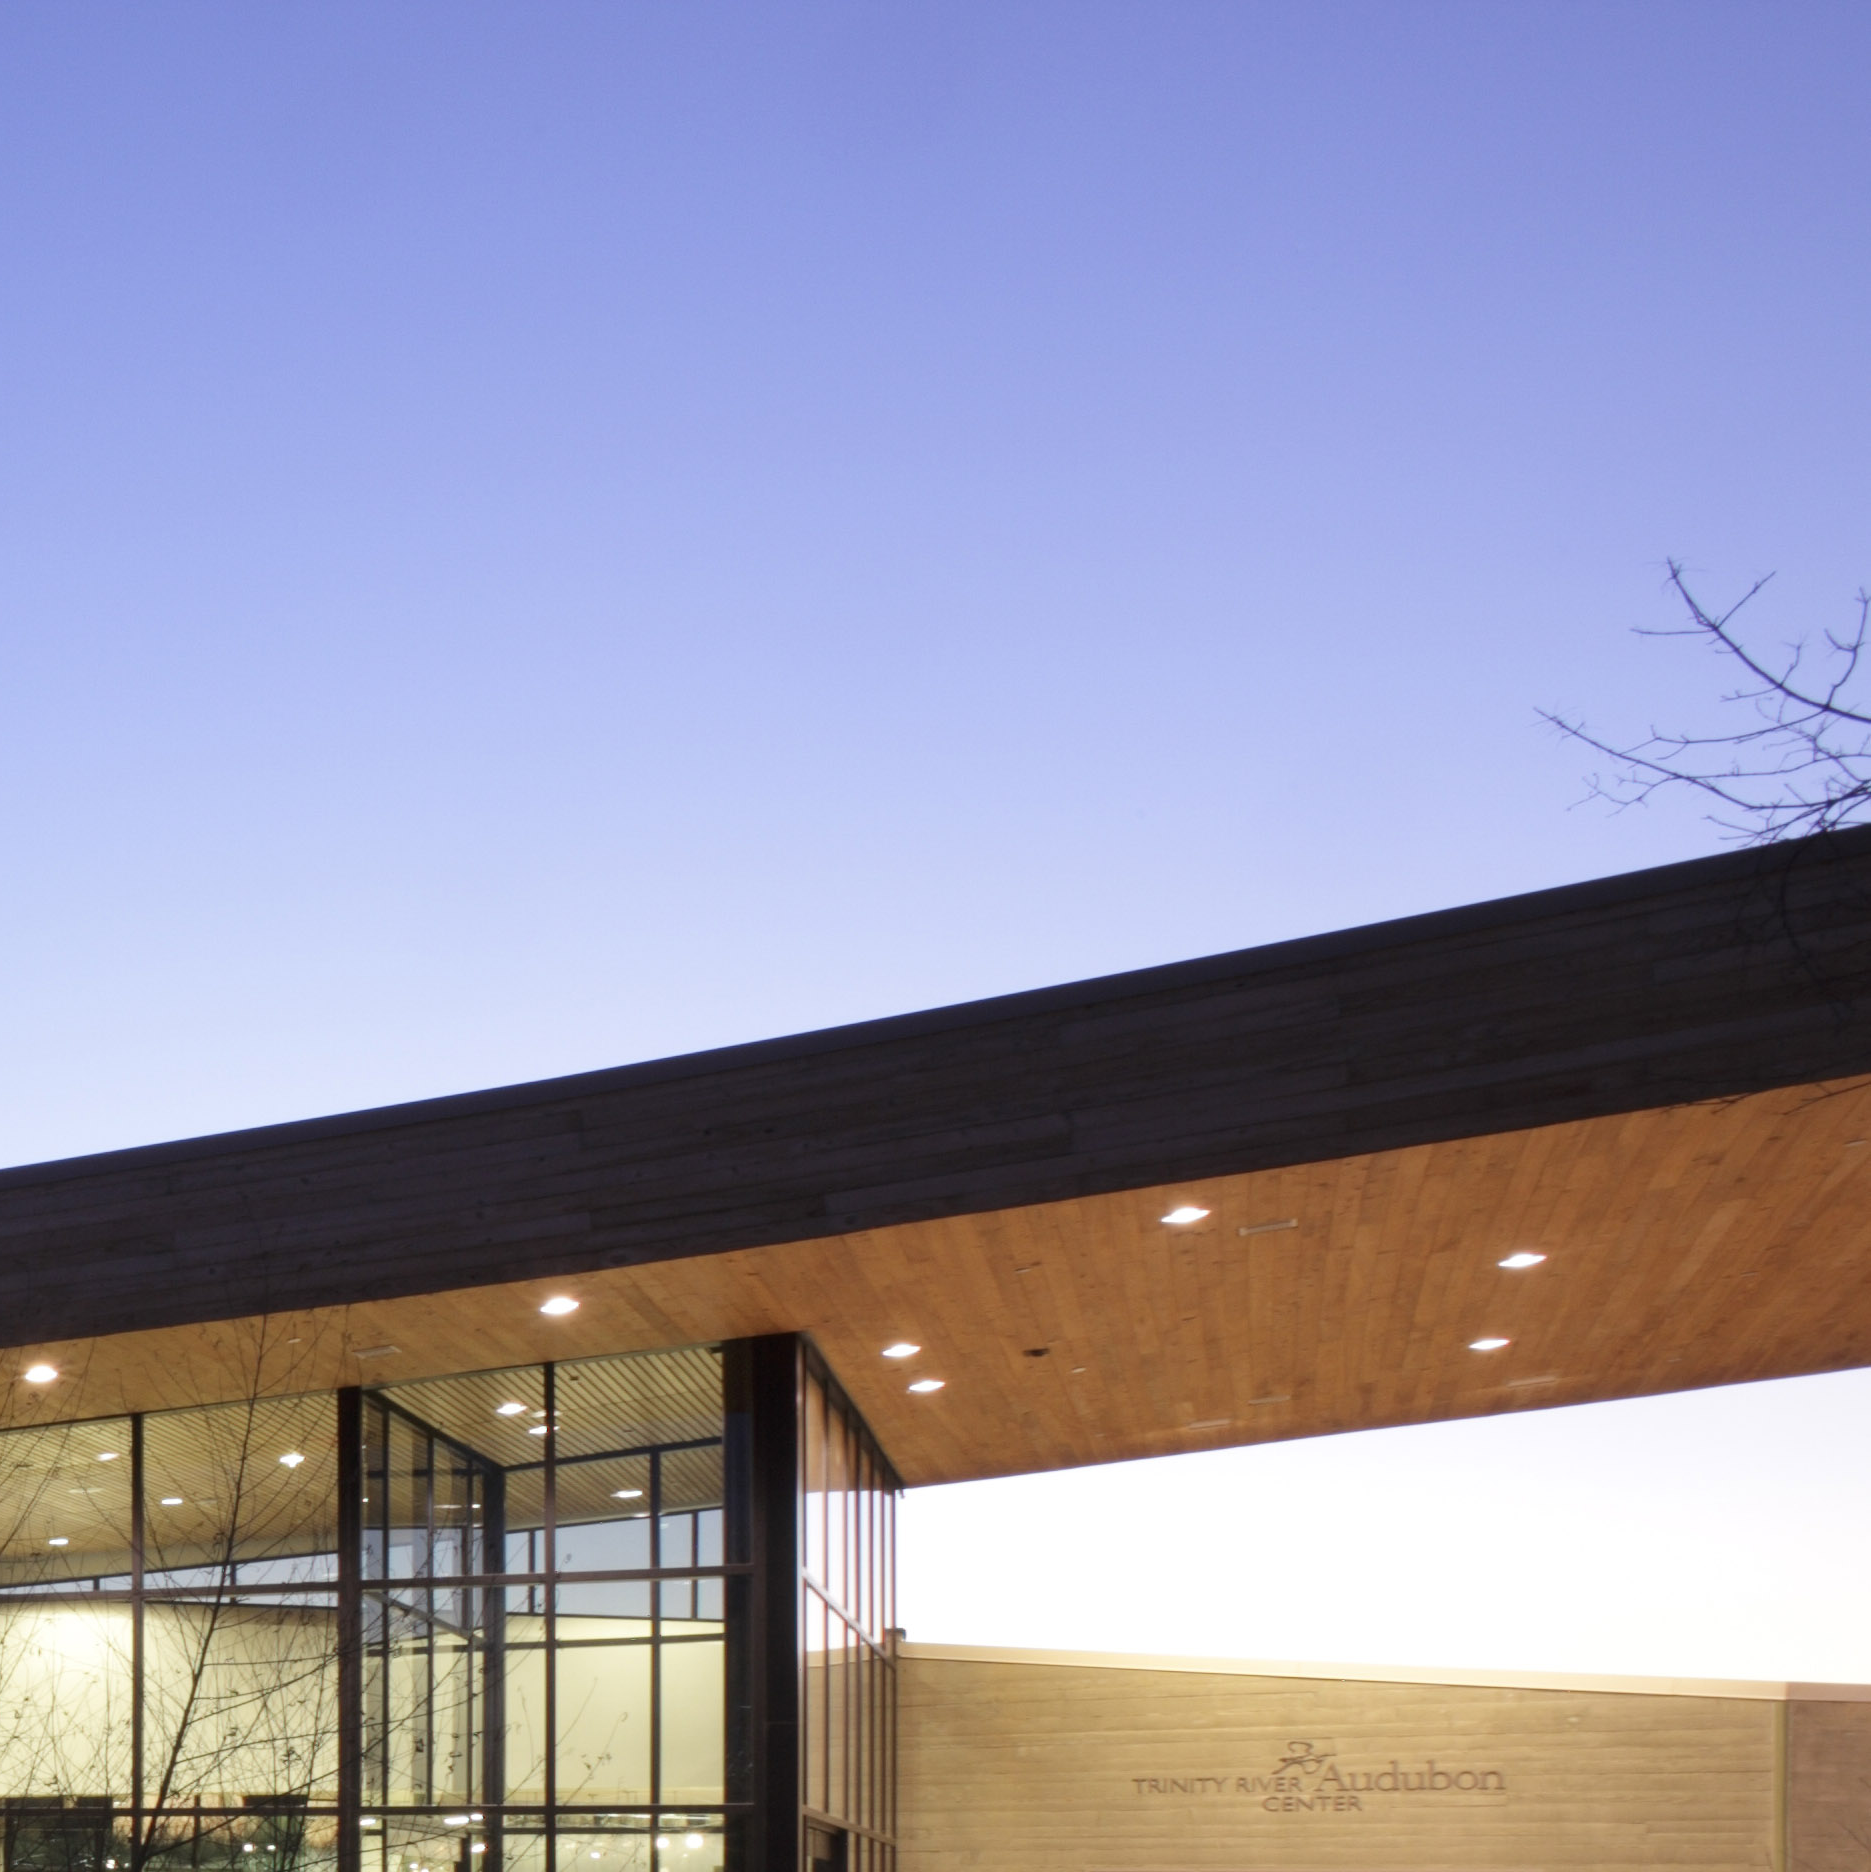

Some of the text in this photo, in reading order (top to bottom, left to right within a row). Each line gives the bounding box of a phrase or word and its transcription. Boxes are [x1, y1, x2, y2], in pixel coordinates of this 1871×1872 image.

[1131, 1759, 1507, 1794] TRINITY RIVER Audubon
[1262, 1795, 1363, 1813] CENTER
